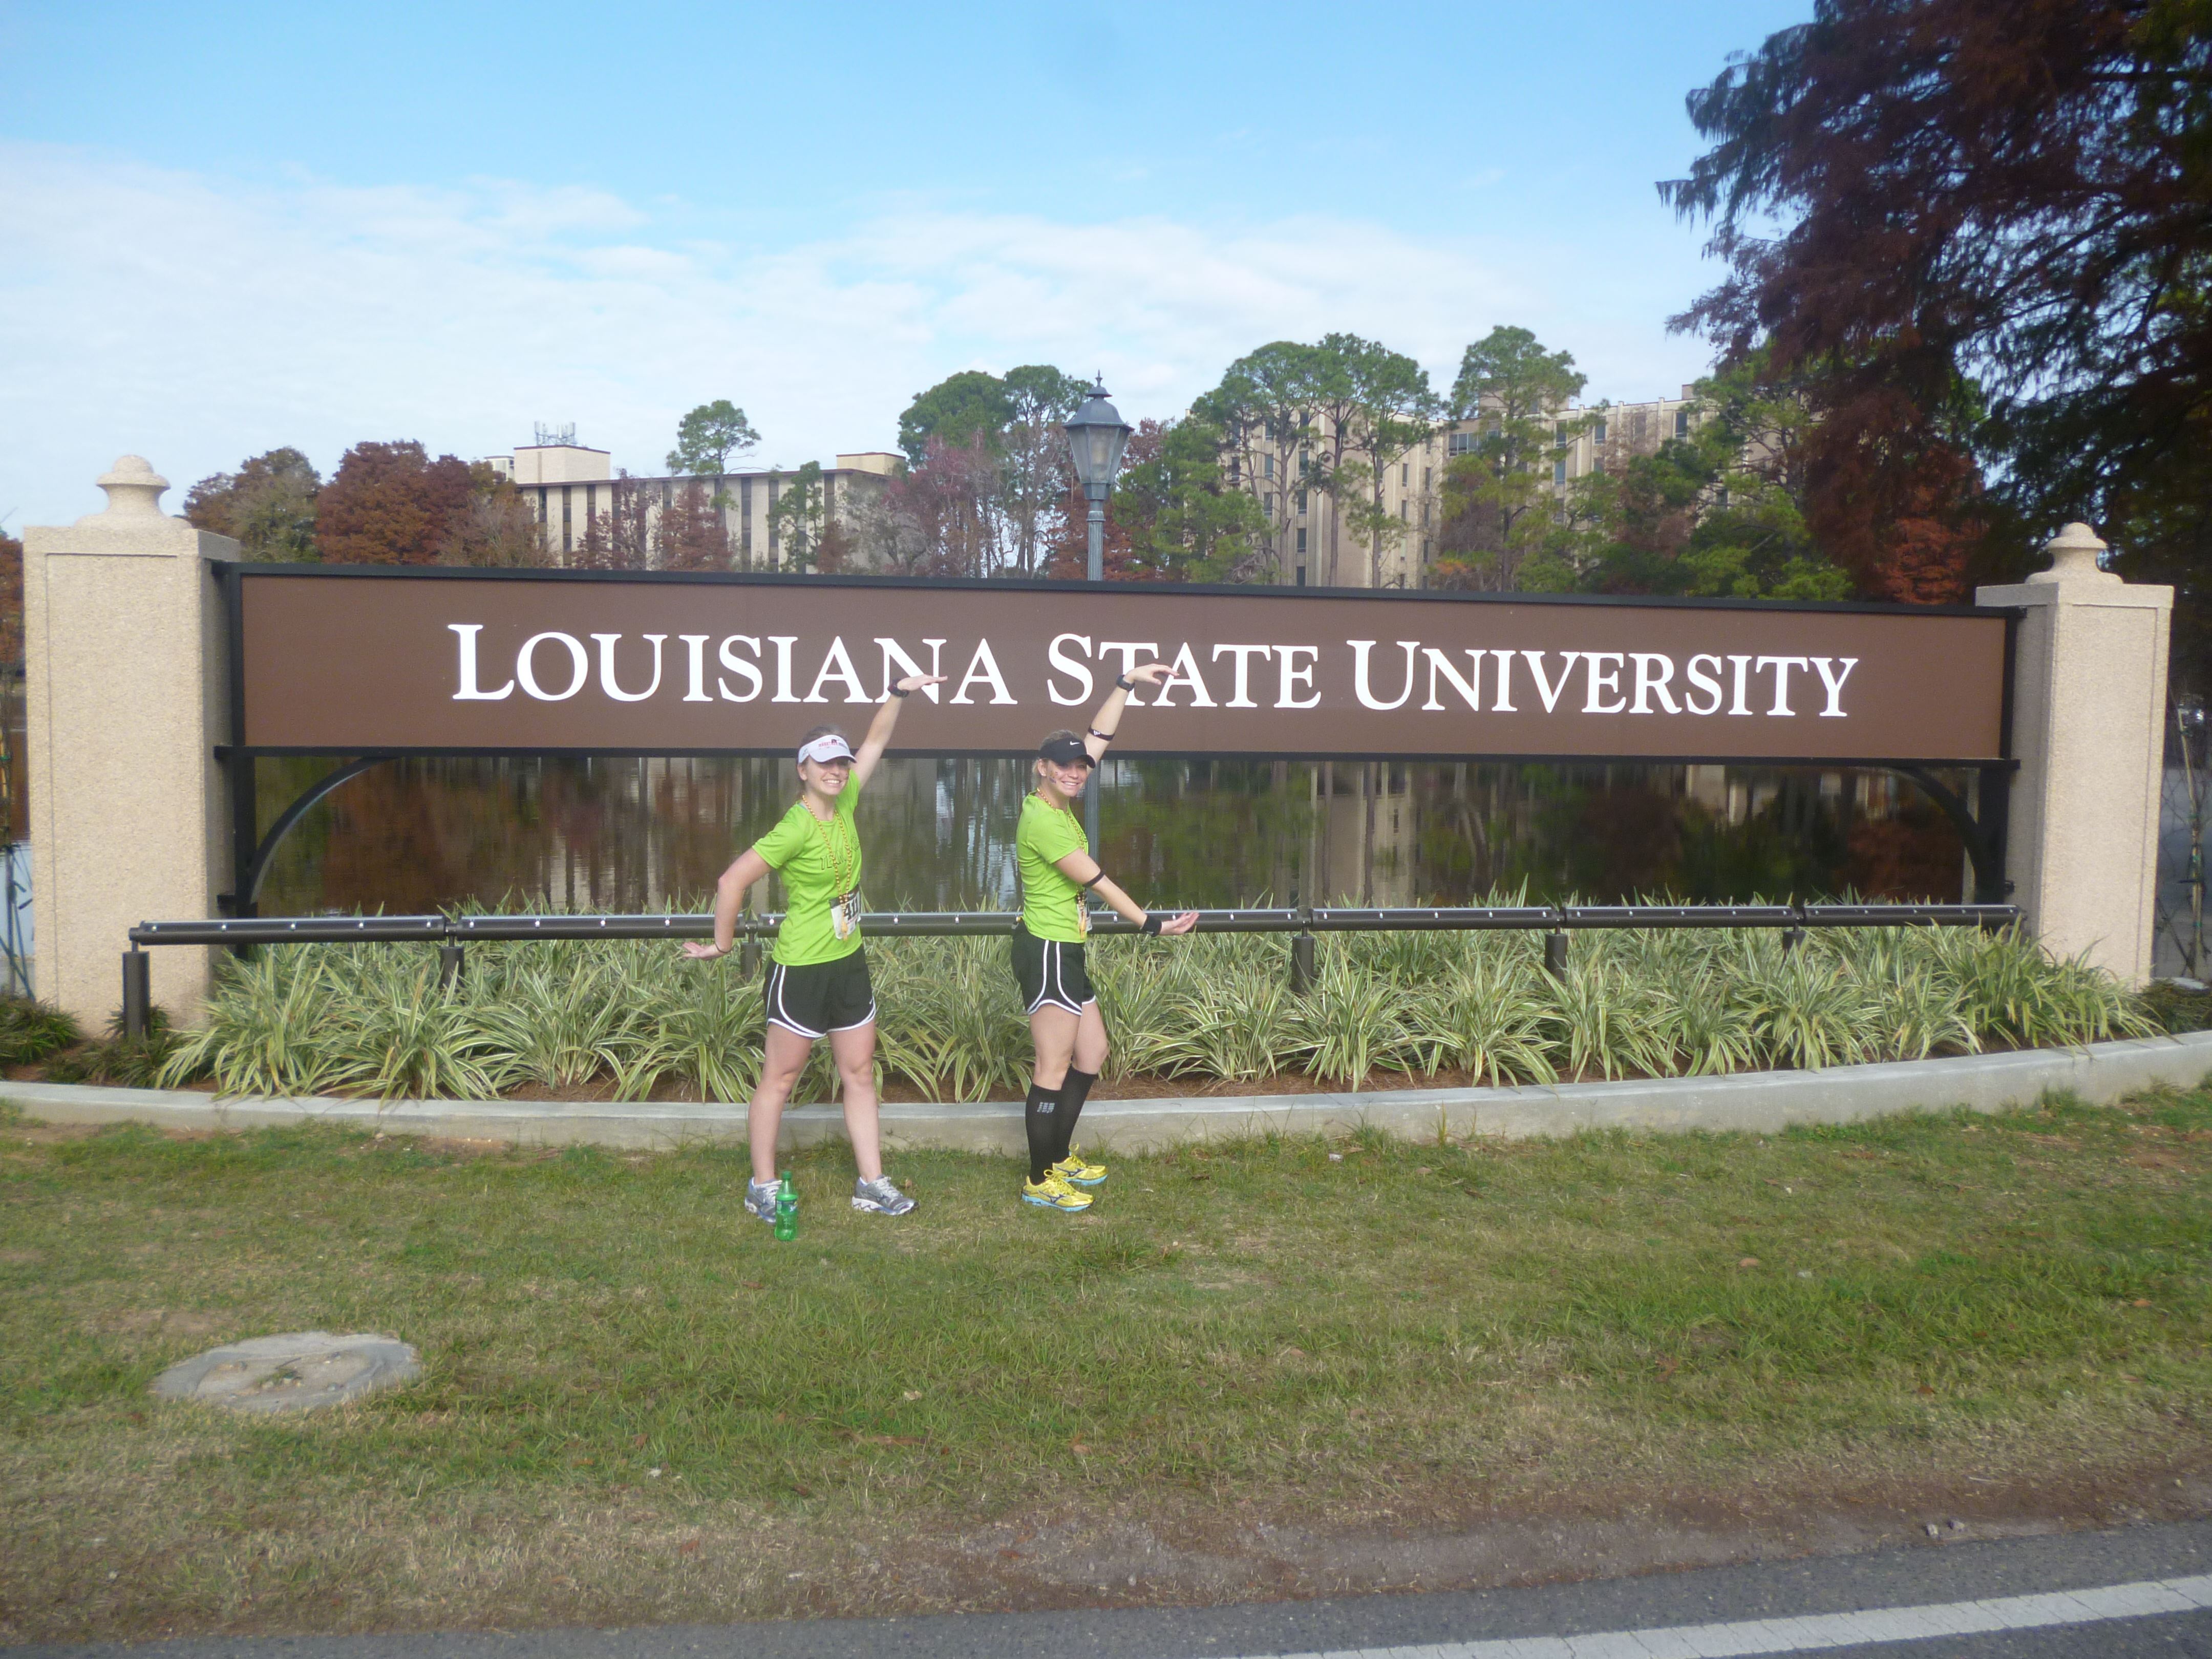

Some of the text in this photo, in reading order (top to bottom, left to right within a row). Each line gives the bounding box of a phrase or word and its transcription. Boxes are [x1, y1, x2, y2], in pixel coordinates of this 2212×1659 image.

[448, 624, 1859, 717] LOUISIANA STATE UNIVERSITY
